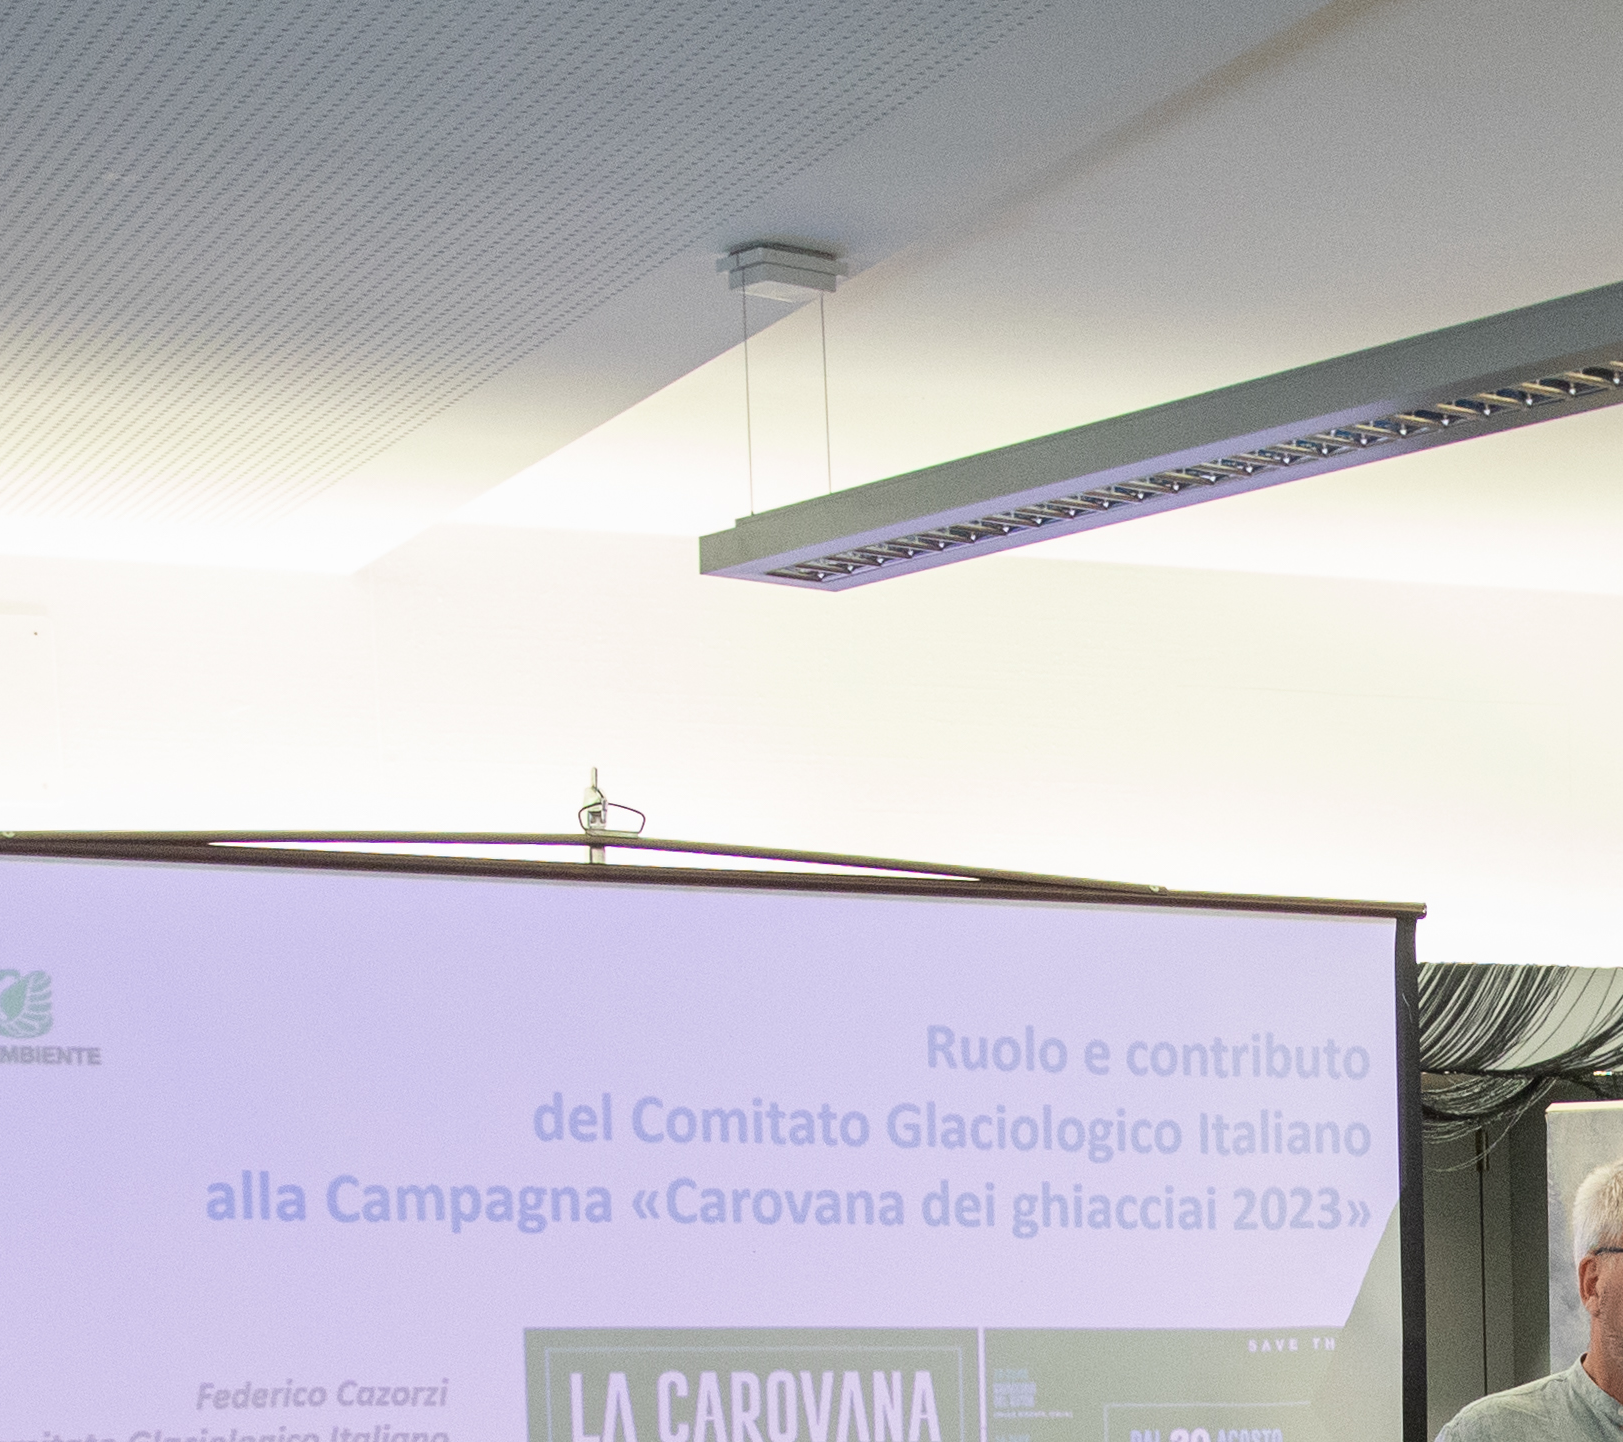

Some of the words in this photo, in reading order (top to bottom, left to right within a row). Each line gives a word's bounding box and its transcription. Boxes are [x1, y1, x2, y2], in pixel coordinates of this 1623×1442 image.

[925, 1024, 1069, 1073] Ruolo
[1083, 1036, 1111, 1076] e
[1125, 1031, 1371, 1081] contributo
[533, 1092, 613, 1142] del
[631, 1096, 871, 1147] Comitato
[886, 1101, 1183, 1165] Glaciologico
[1199, 1110, 1371, 1158] Italiano
[205, 1171, 307, 1222] alla
[325, 1175, 613, 1234] Campagna
[632, 1178, 907, 1227] «Carovana
[921, 1180, 996, 1230] dei
[1011, 1183, 1217, 1240] ghiacciai
[1231, 1187, 1371, 1232] 2023»
[196, 1381, 327, 1412] Federico
[335, 1378, 449, 1409] Cazorzi
